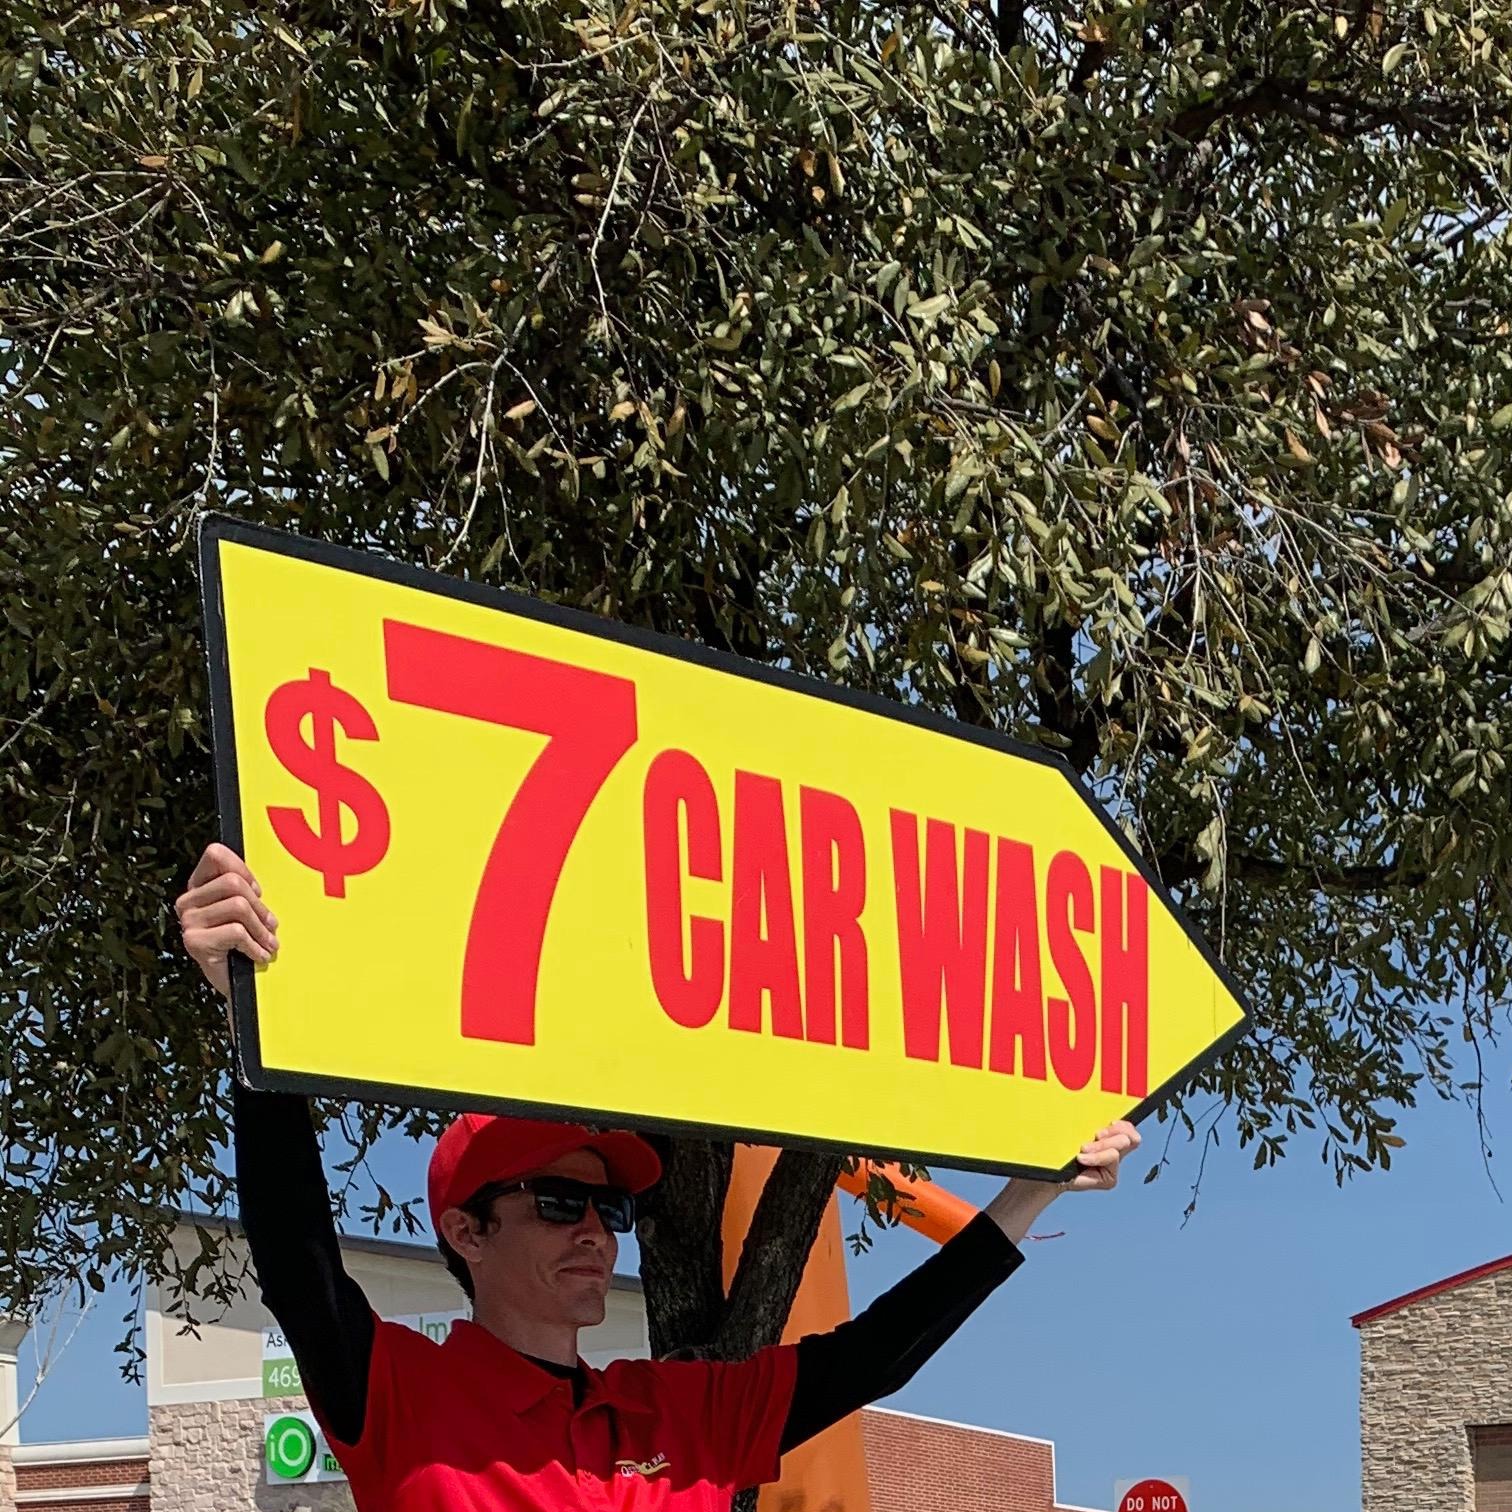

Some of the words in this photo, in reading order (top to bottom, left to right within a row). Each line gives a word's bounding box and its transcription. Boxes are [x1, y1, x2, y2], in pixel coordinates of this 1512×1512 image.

[643, 748, 870, 1050] CAR
[889, 808, 1148, 1098] WASH
[1127, 1497, 1144, 1511] DO
[1152, 1496, 1178, 1510] NOT
